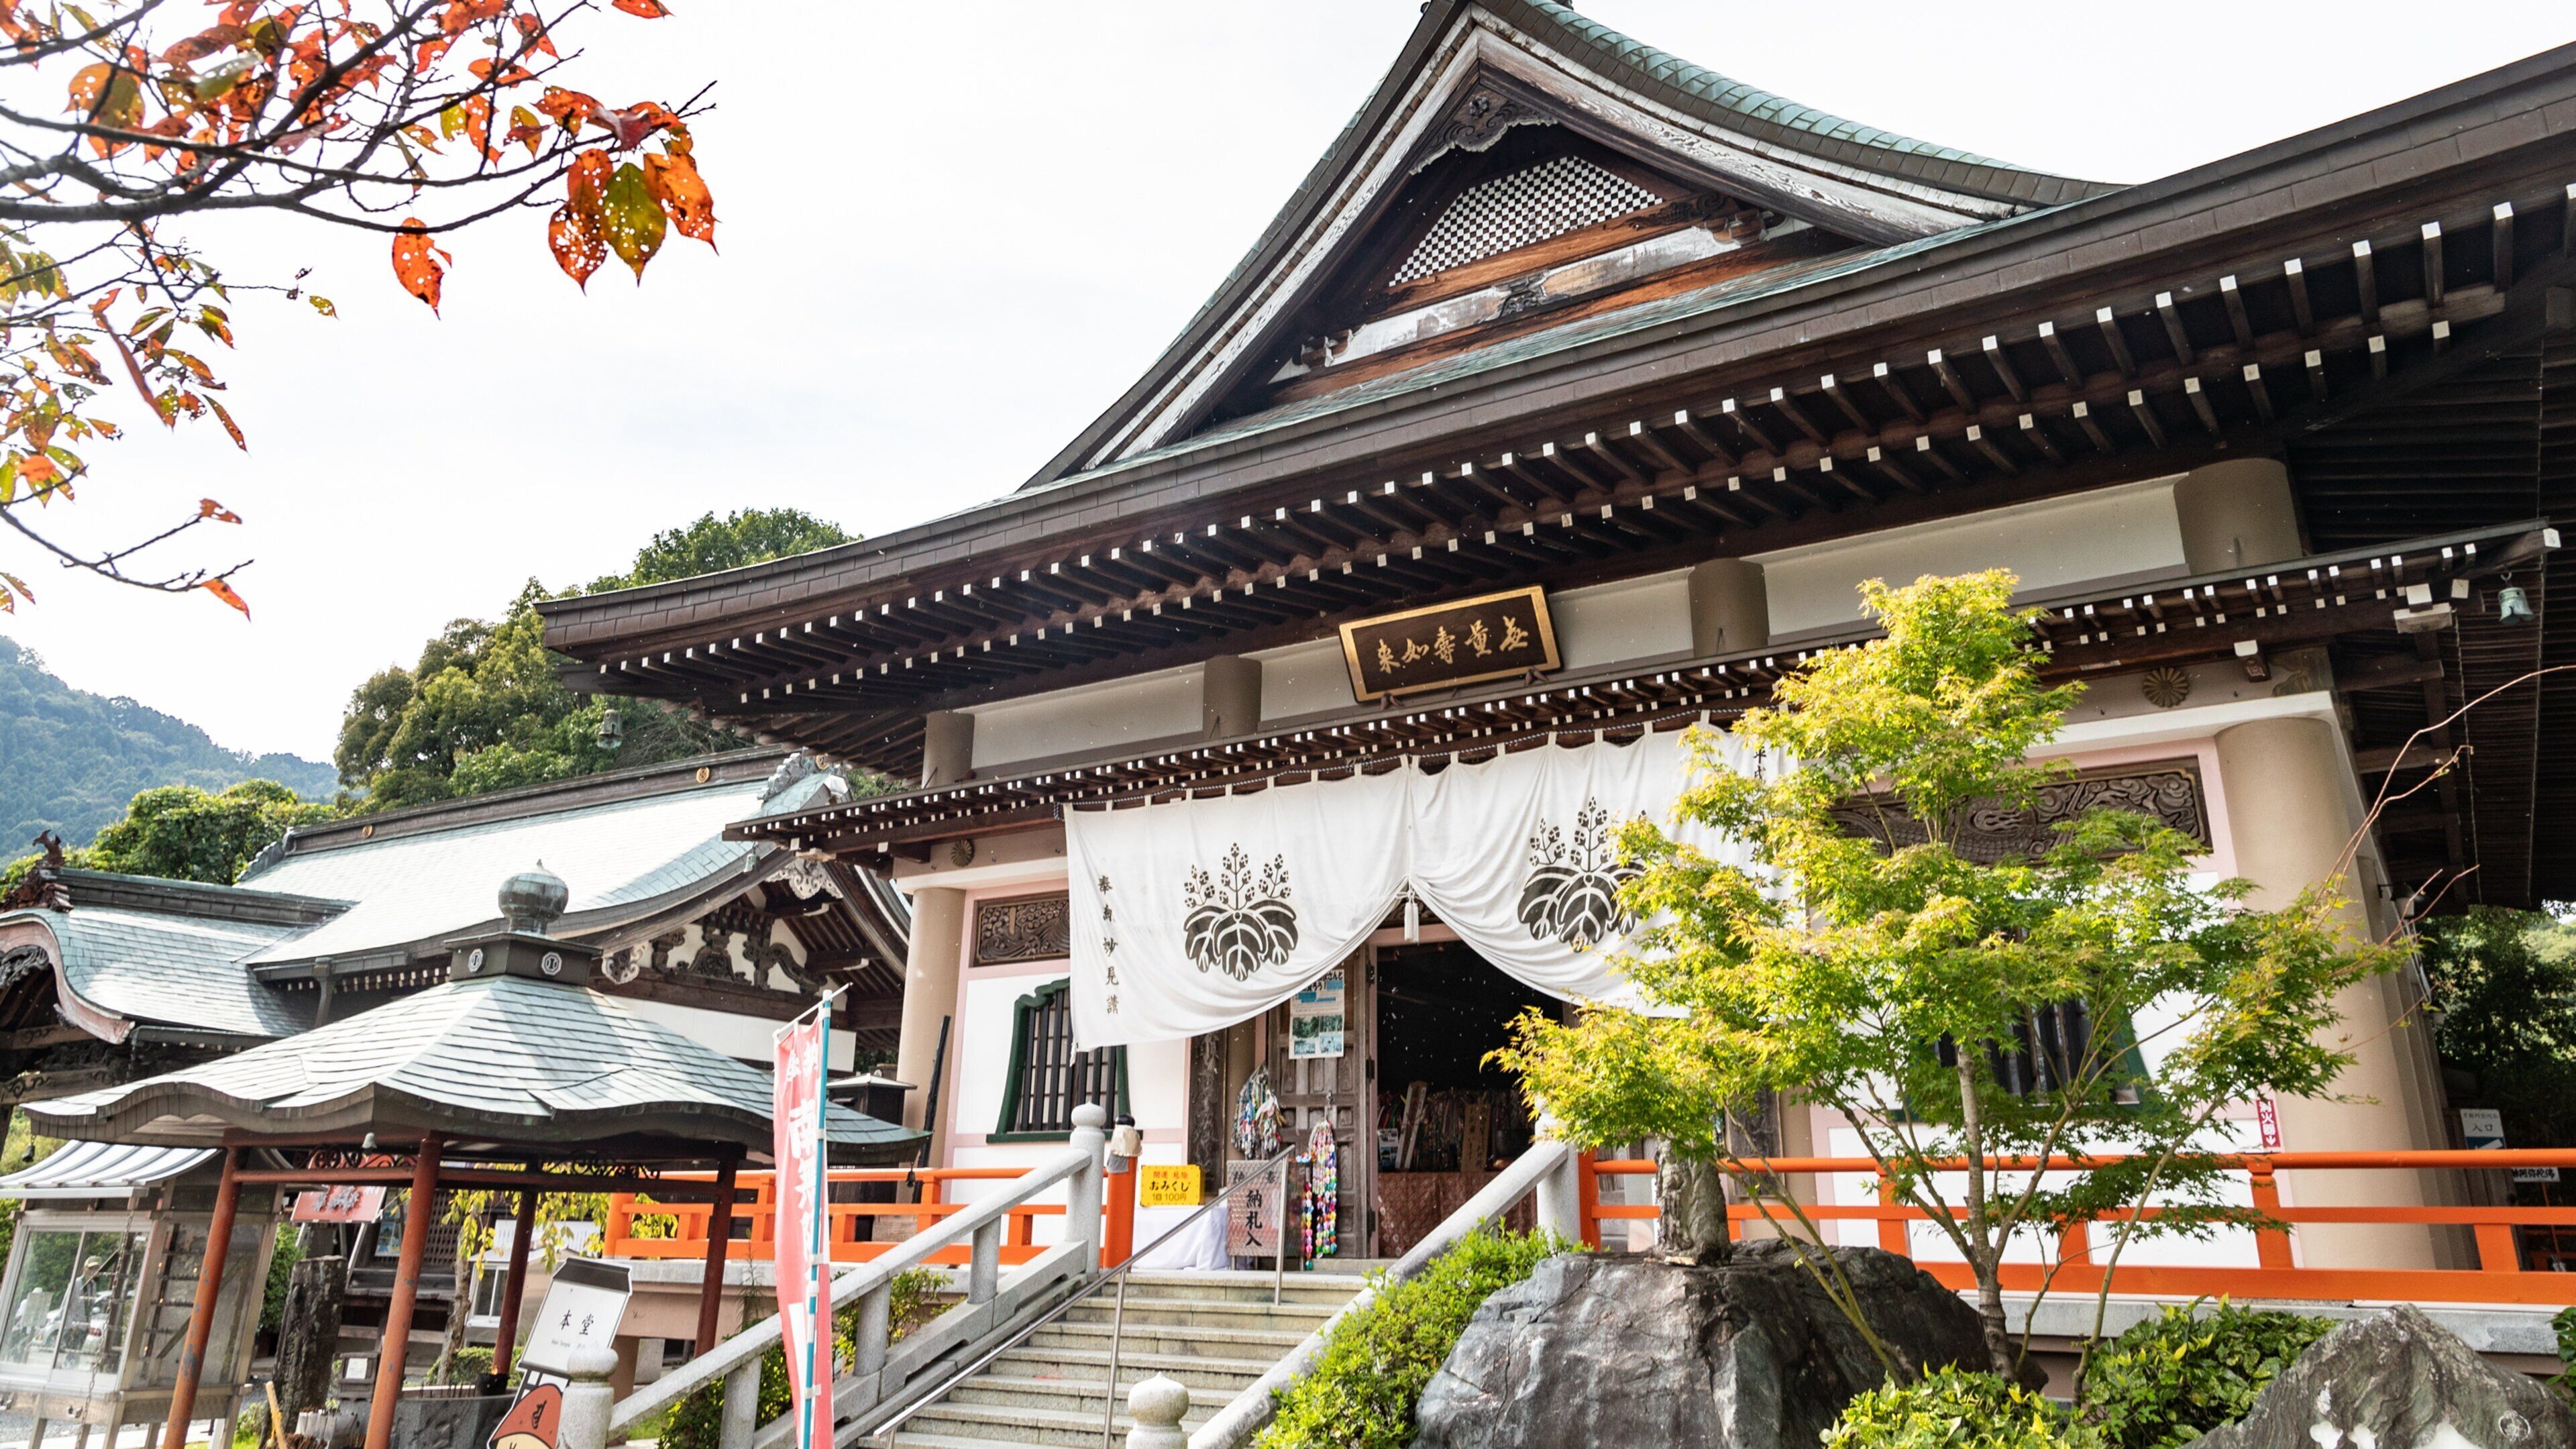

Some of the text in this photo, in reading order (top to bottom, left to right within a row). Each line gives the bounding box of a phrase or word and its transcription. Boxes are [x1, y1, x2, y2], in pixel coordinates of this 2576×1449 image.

[2473, 1124, 2493, 1132] 入口
[1149, 1181, 1191, 1192] おみくじ
[1165, 1193, 1187, 1201] 100円
[1246, 1190, 1263, 1246] 納札入
[559, 1309, 594, 1335] 本堂
